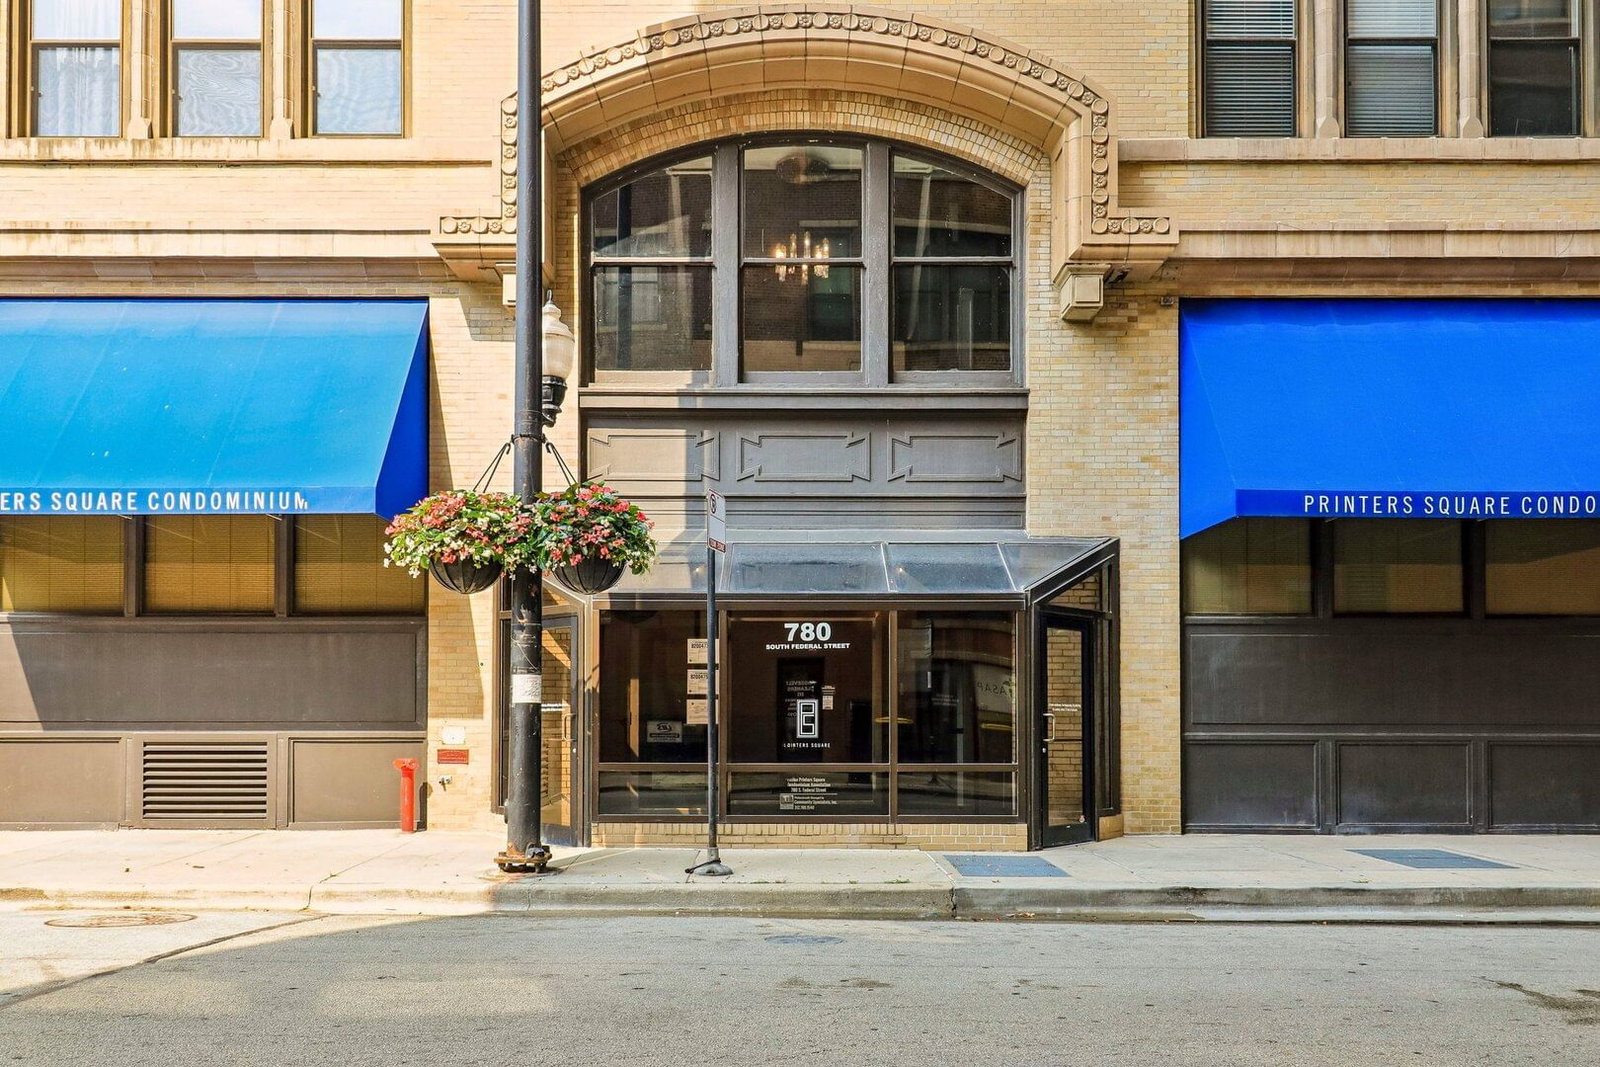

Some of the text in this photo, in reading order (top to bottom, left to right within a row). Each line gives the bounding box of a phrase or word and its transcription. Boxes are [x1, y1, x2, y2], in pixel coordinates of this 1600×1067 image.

[0, 491, 308, 512] ERS SQUARE CONDOMINIUM
[1304, 495, 1596, 516] PRINTERS SQUARE CONDO
[784, 622, 832, 641] 780
